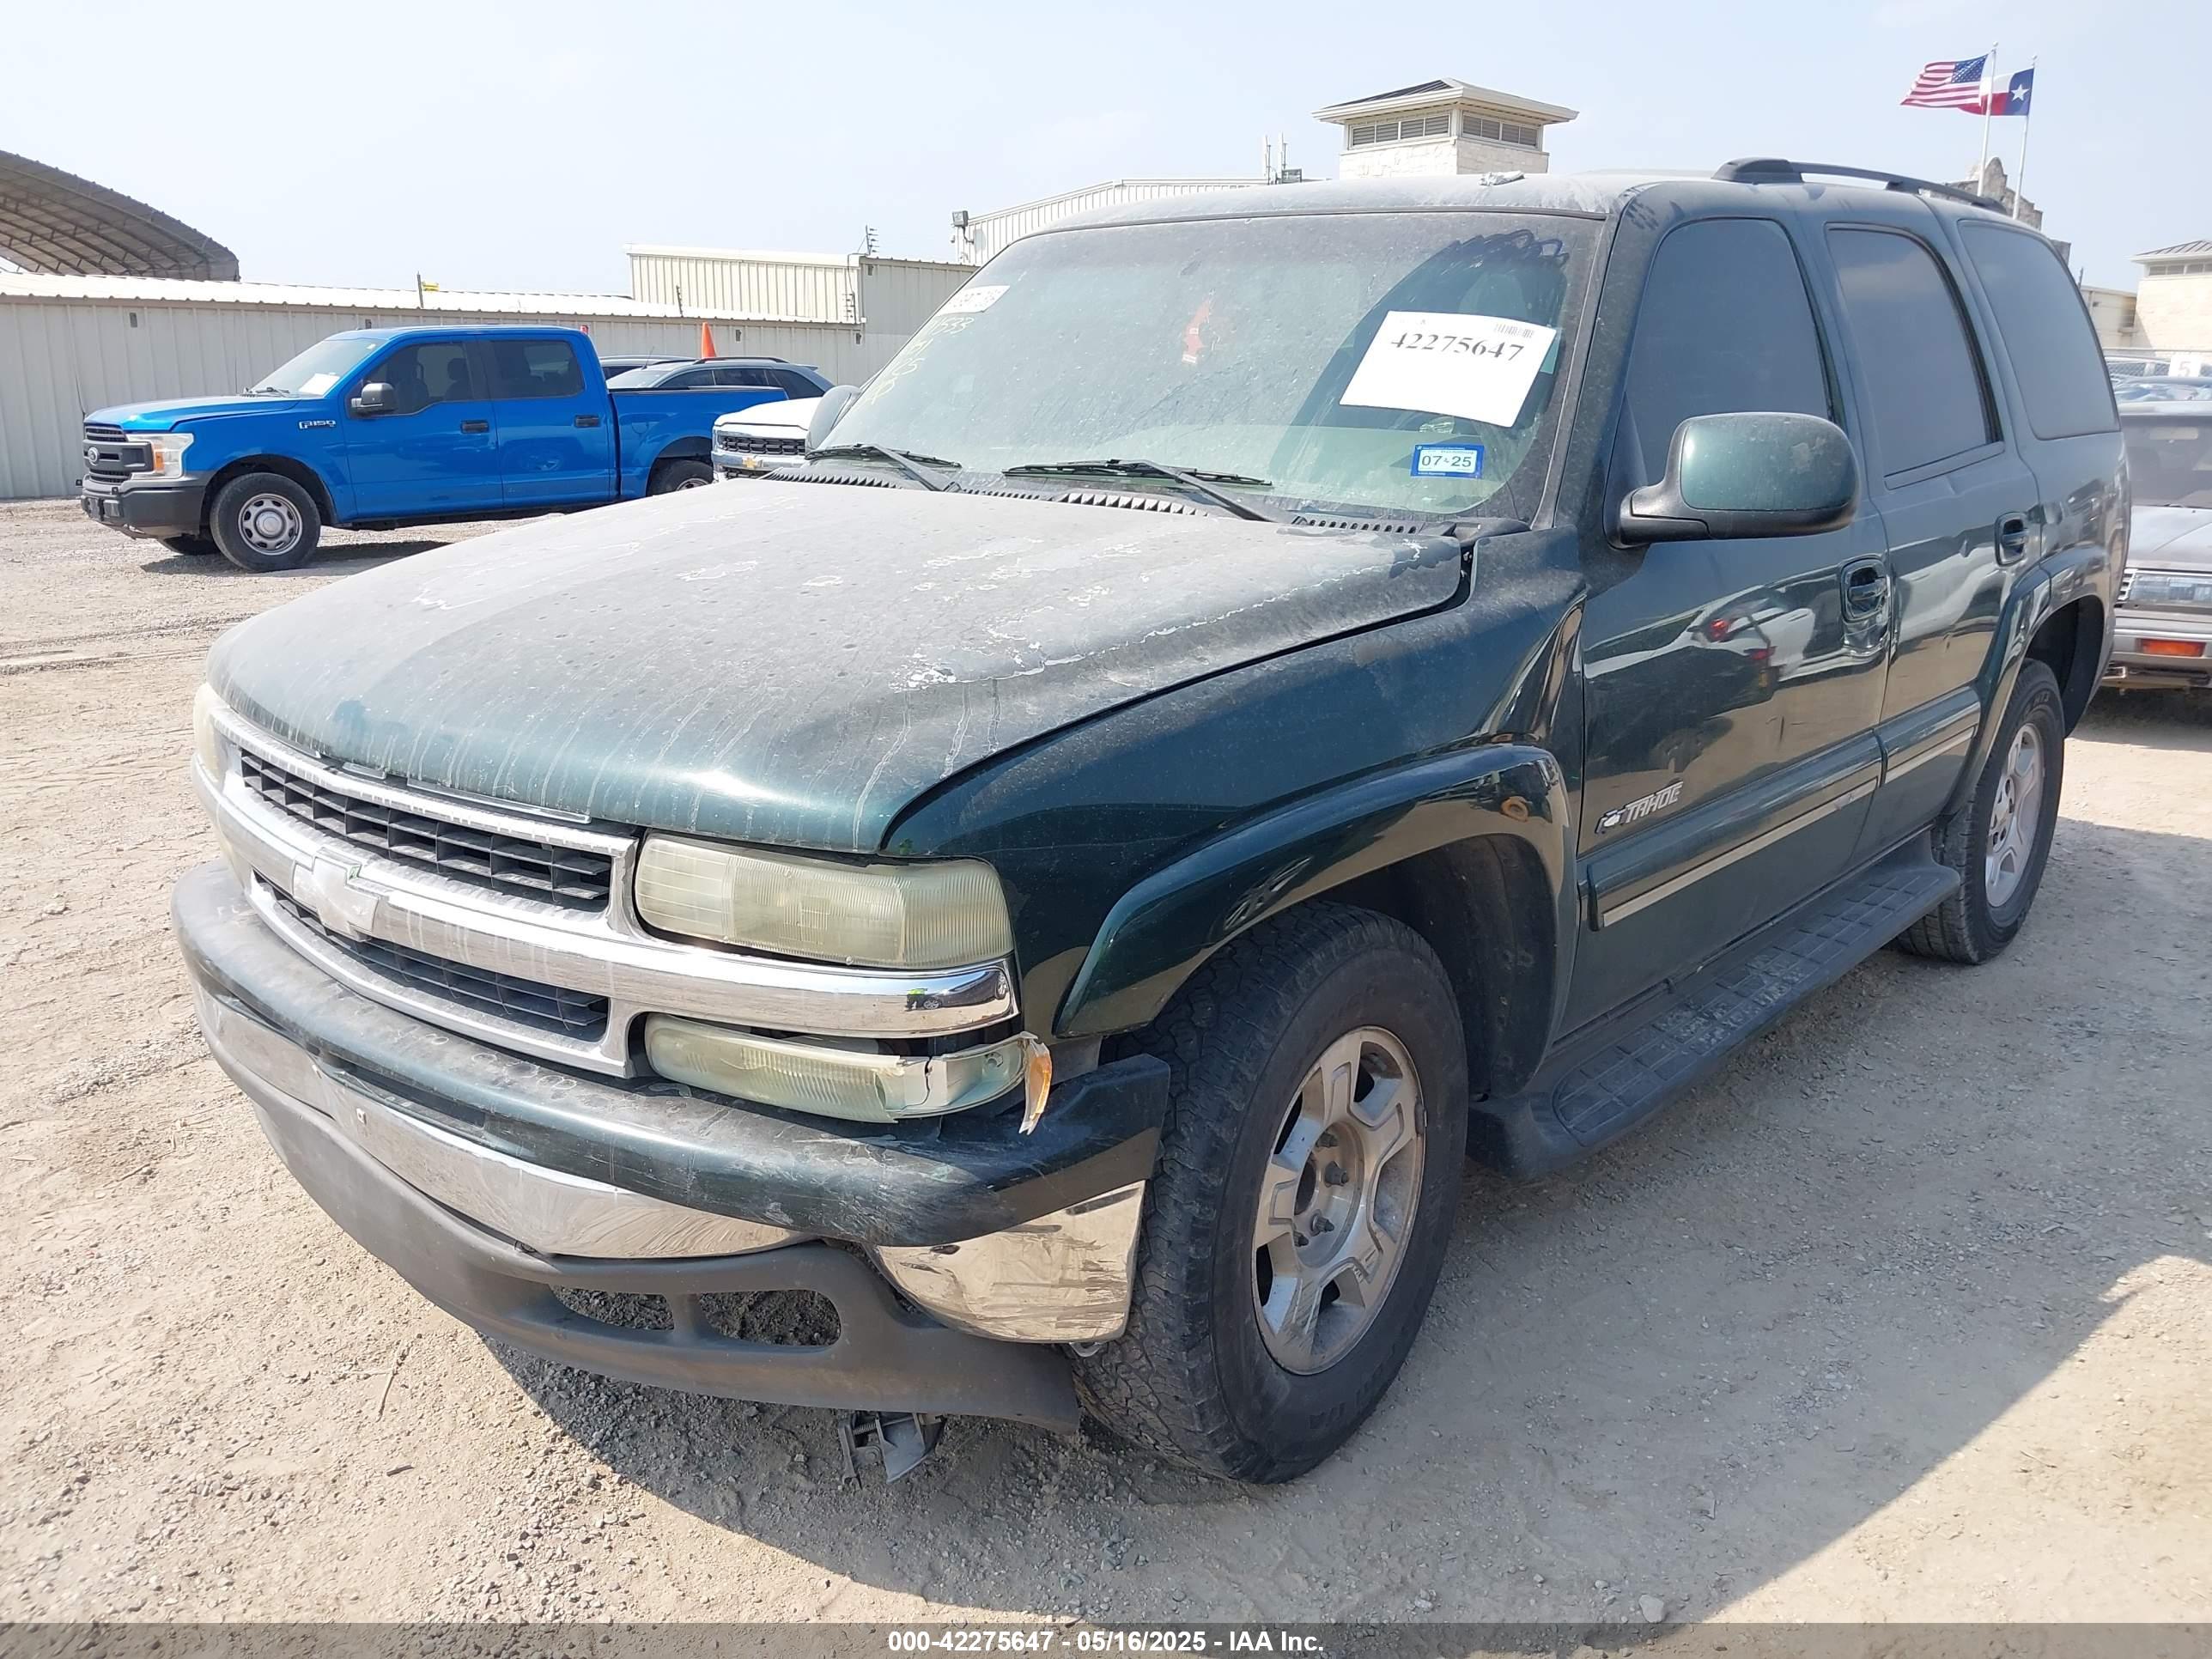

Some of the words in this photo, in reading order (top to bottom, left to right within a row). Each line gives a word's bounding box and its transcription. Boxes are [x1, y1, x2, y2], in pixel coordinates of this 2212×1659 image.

[1391, 331, 1524, 361] 42275647
[1421, 455, 1443, 466] 07
[1450, 455, 1472, 467] 25
[1625, 781, 1684, 823] TAHOE
